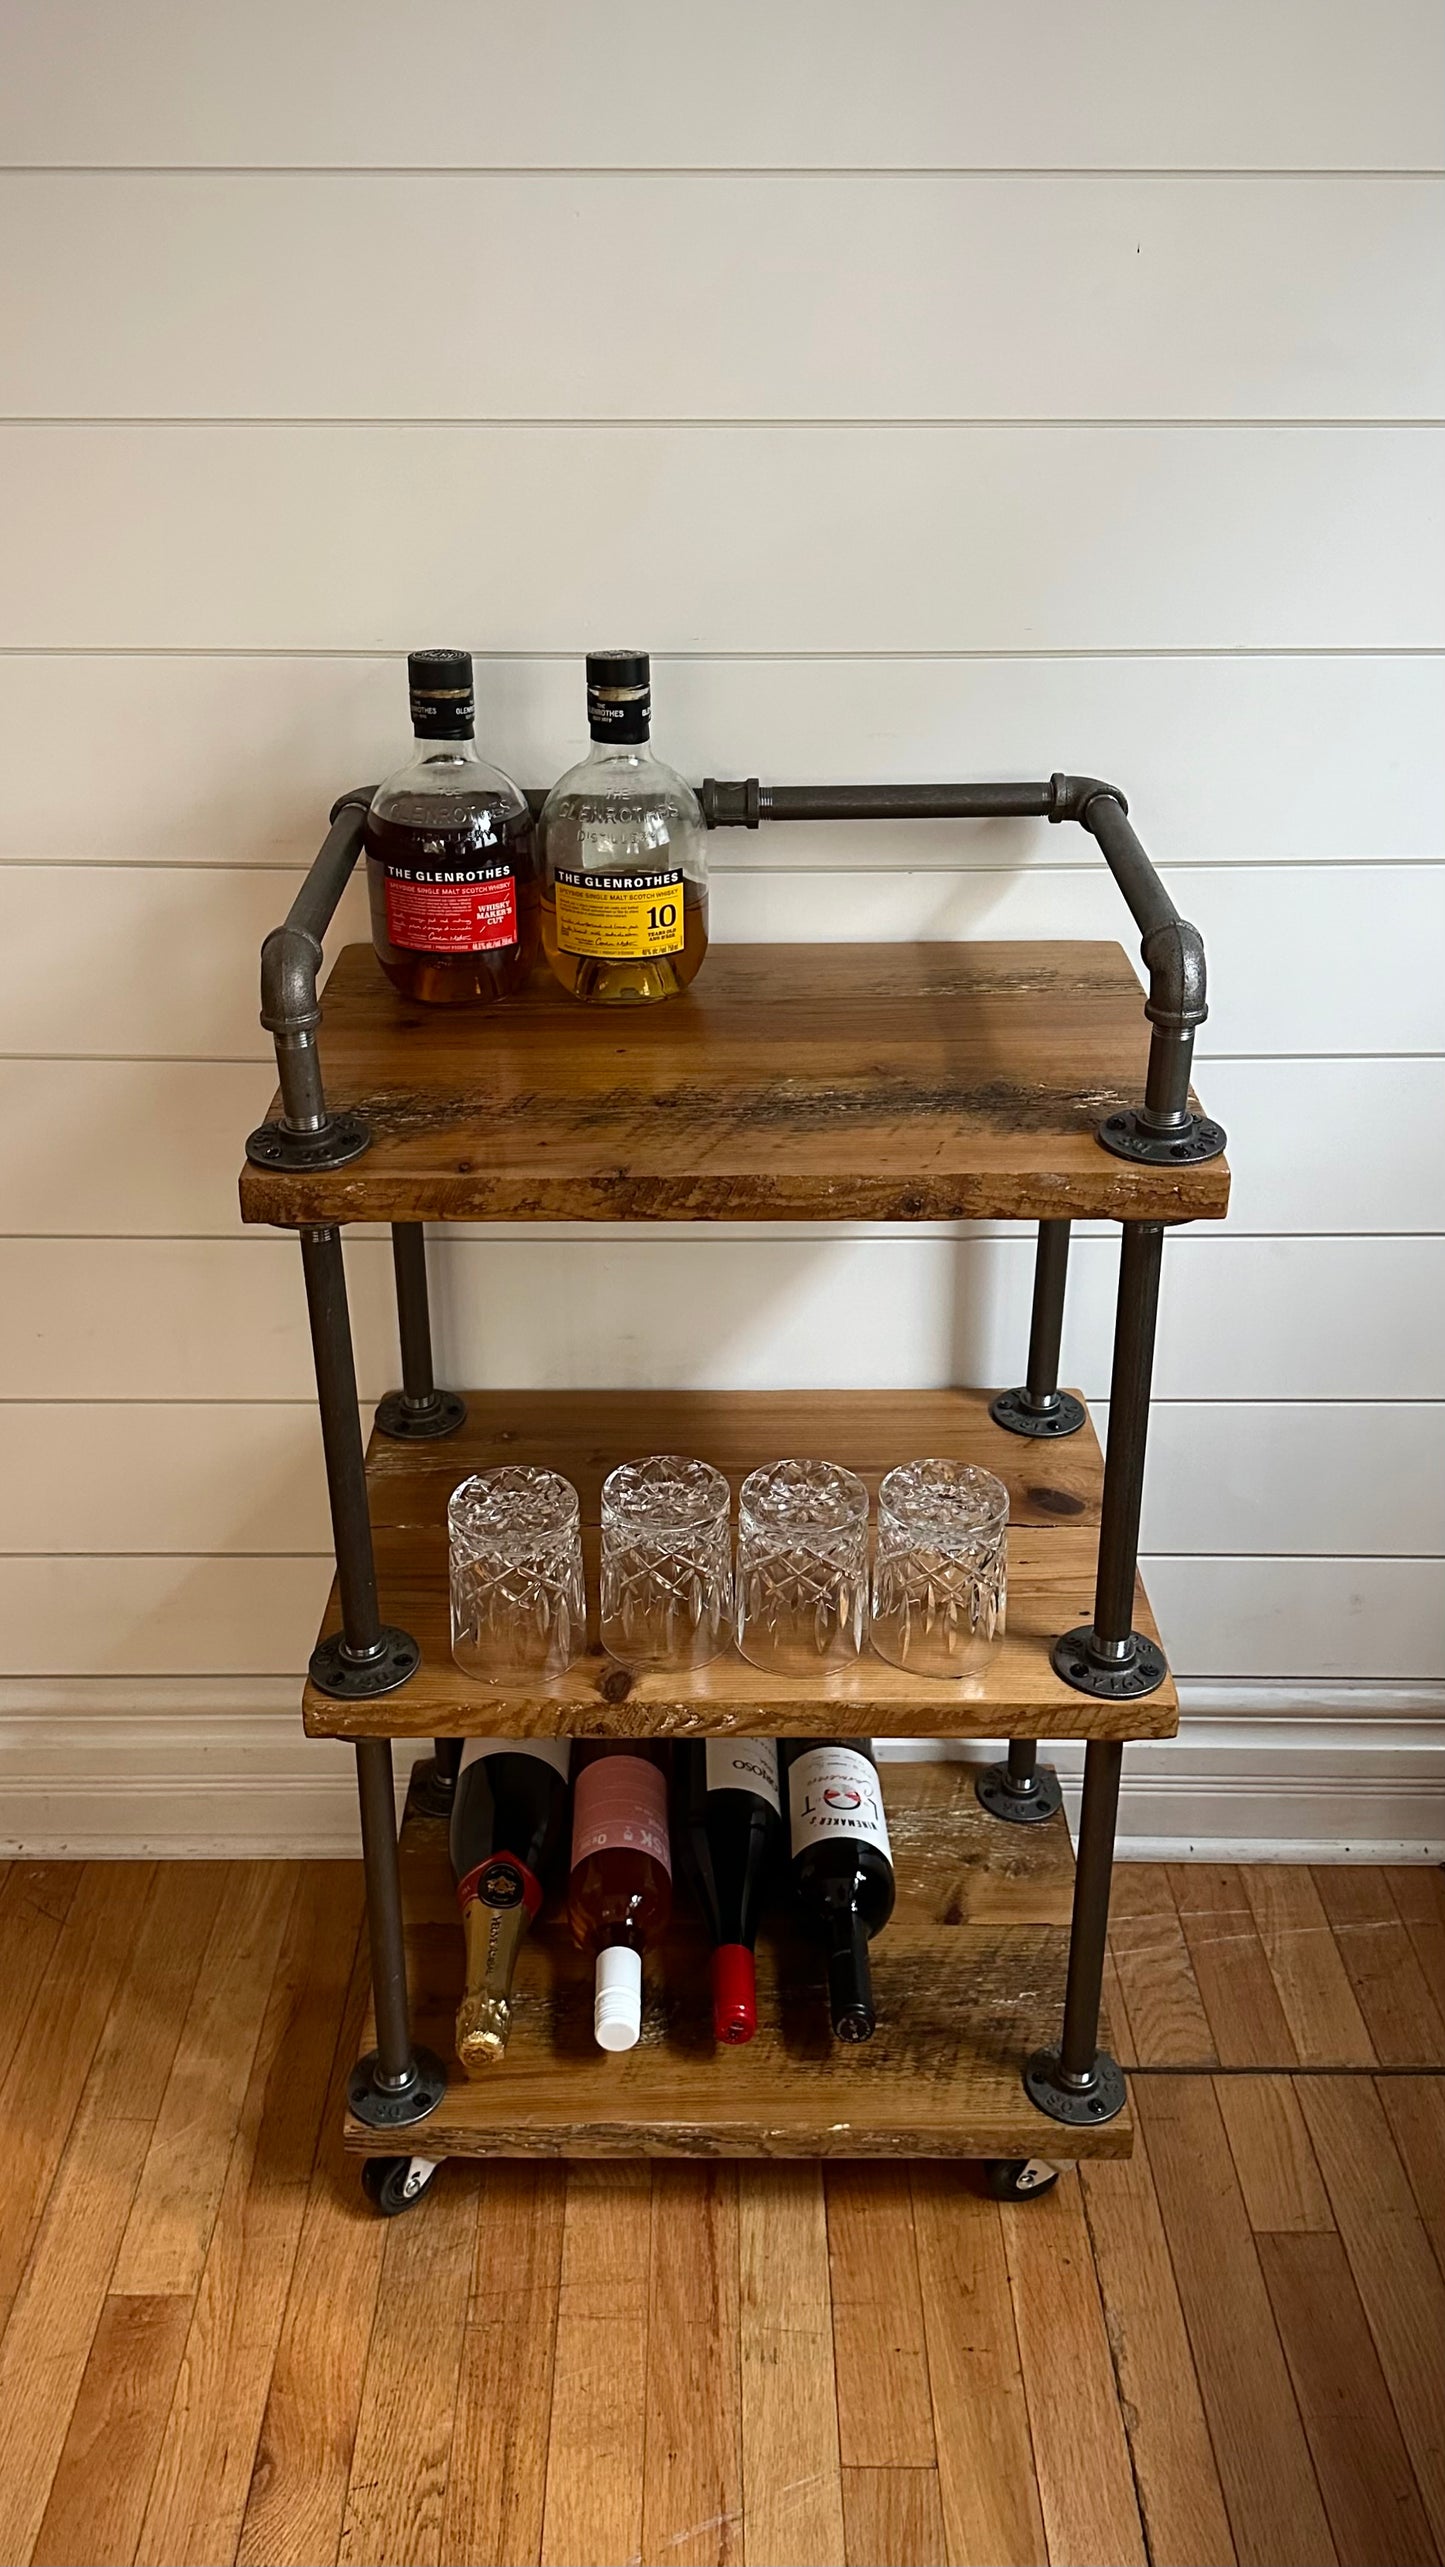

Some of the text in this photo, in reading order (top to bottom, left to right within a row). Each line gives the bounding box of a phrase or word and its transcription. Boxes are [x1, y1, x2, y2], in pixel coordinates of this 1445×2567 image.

[388, 865, 511, 882] THE GLENROTHES
[558, 871, 679, 888] THE GLENROTHES
[416, 886, 440, 895] SINGLE
[441, 887, 460, 895] MALT
[461, 885, 488, 895] SCOTCH
[488, 881, 511, 892] WHISKY
[585, 892, 608, 901] SINGLE
[609, 892, 628, 901] MALT
[629, 890, 655, 901] SCOTCH
[655, 888, 679, 898] WHISKY
[476, 906, 513, 920] MAKER'S
[478, 900, 511, 913] WHISKY
[486, 915, 506, 926] CUT
[646, 904, 677, 930] 10
[801, 1788, 879, 1821] LOT
[808, 1816, 878, 1831] WINEMAKER'S
